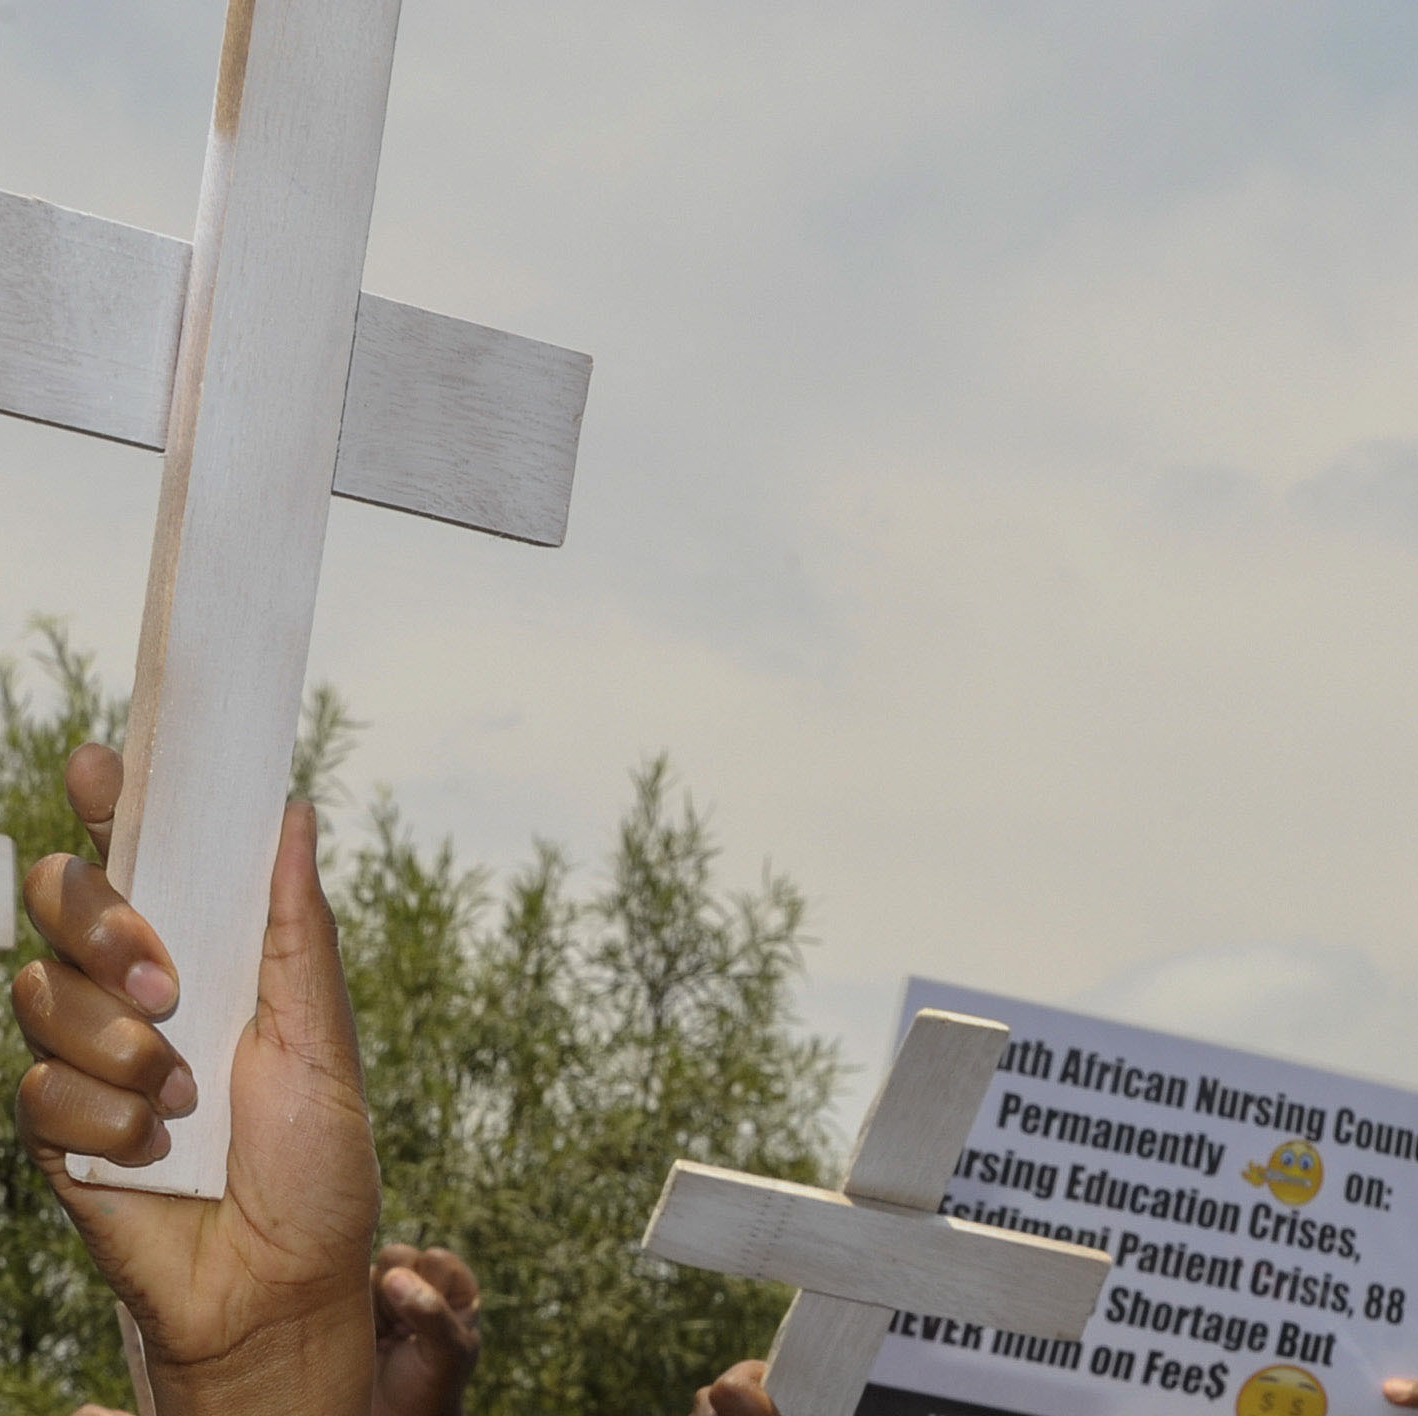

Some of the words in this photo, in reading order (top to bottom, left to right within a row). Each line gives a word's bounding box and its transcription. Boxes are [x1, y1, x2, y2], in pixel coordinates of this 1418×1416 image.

[1058, 1046, 1189, 1109] African
[1195, 1075, 1326, 1143] Nursing
[997, 1091, 1226, 1177] Permanently
[1344, 1172, 1393, 1212] on:
[1064, 1162, 1241, 1234] Education
[1248, 1202, 1361, 1264] Crises,
[1115, 1231, 1245, 1292] Patient
[1249, 1259, 1355, 1318] Crisis,
[1364, 1283, 1405, 1325] 88
[1090, 1344, 1136, 1380] on
[1142, 1349, 1230, 1401] Fee$
[1105, 1285, 1269, 1351] Shortage
[1276, 1321, 1336, 1367] But
